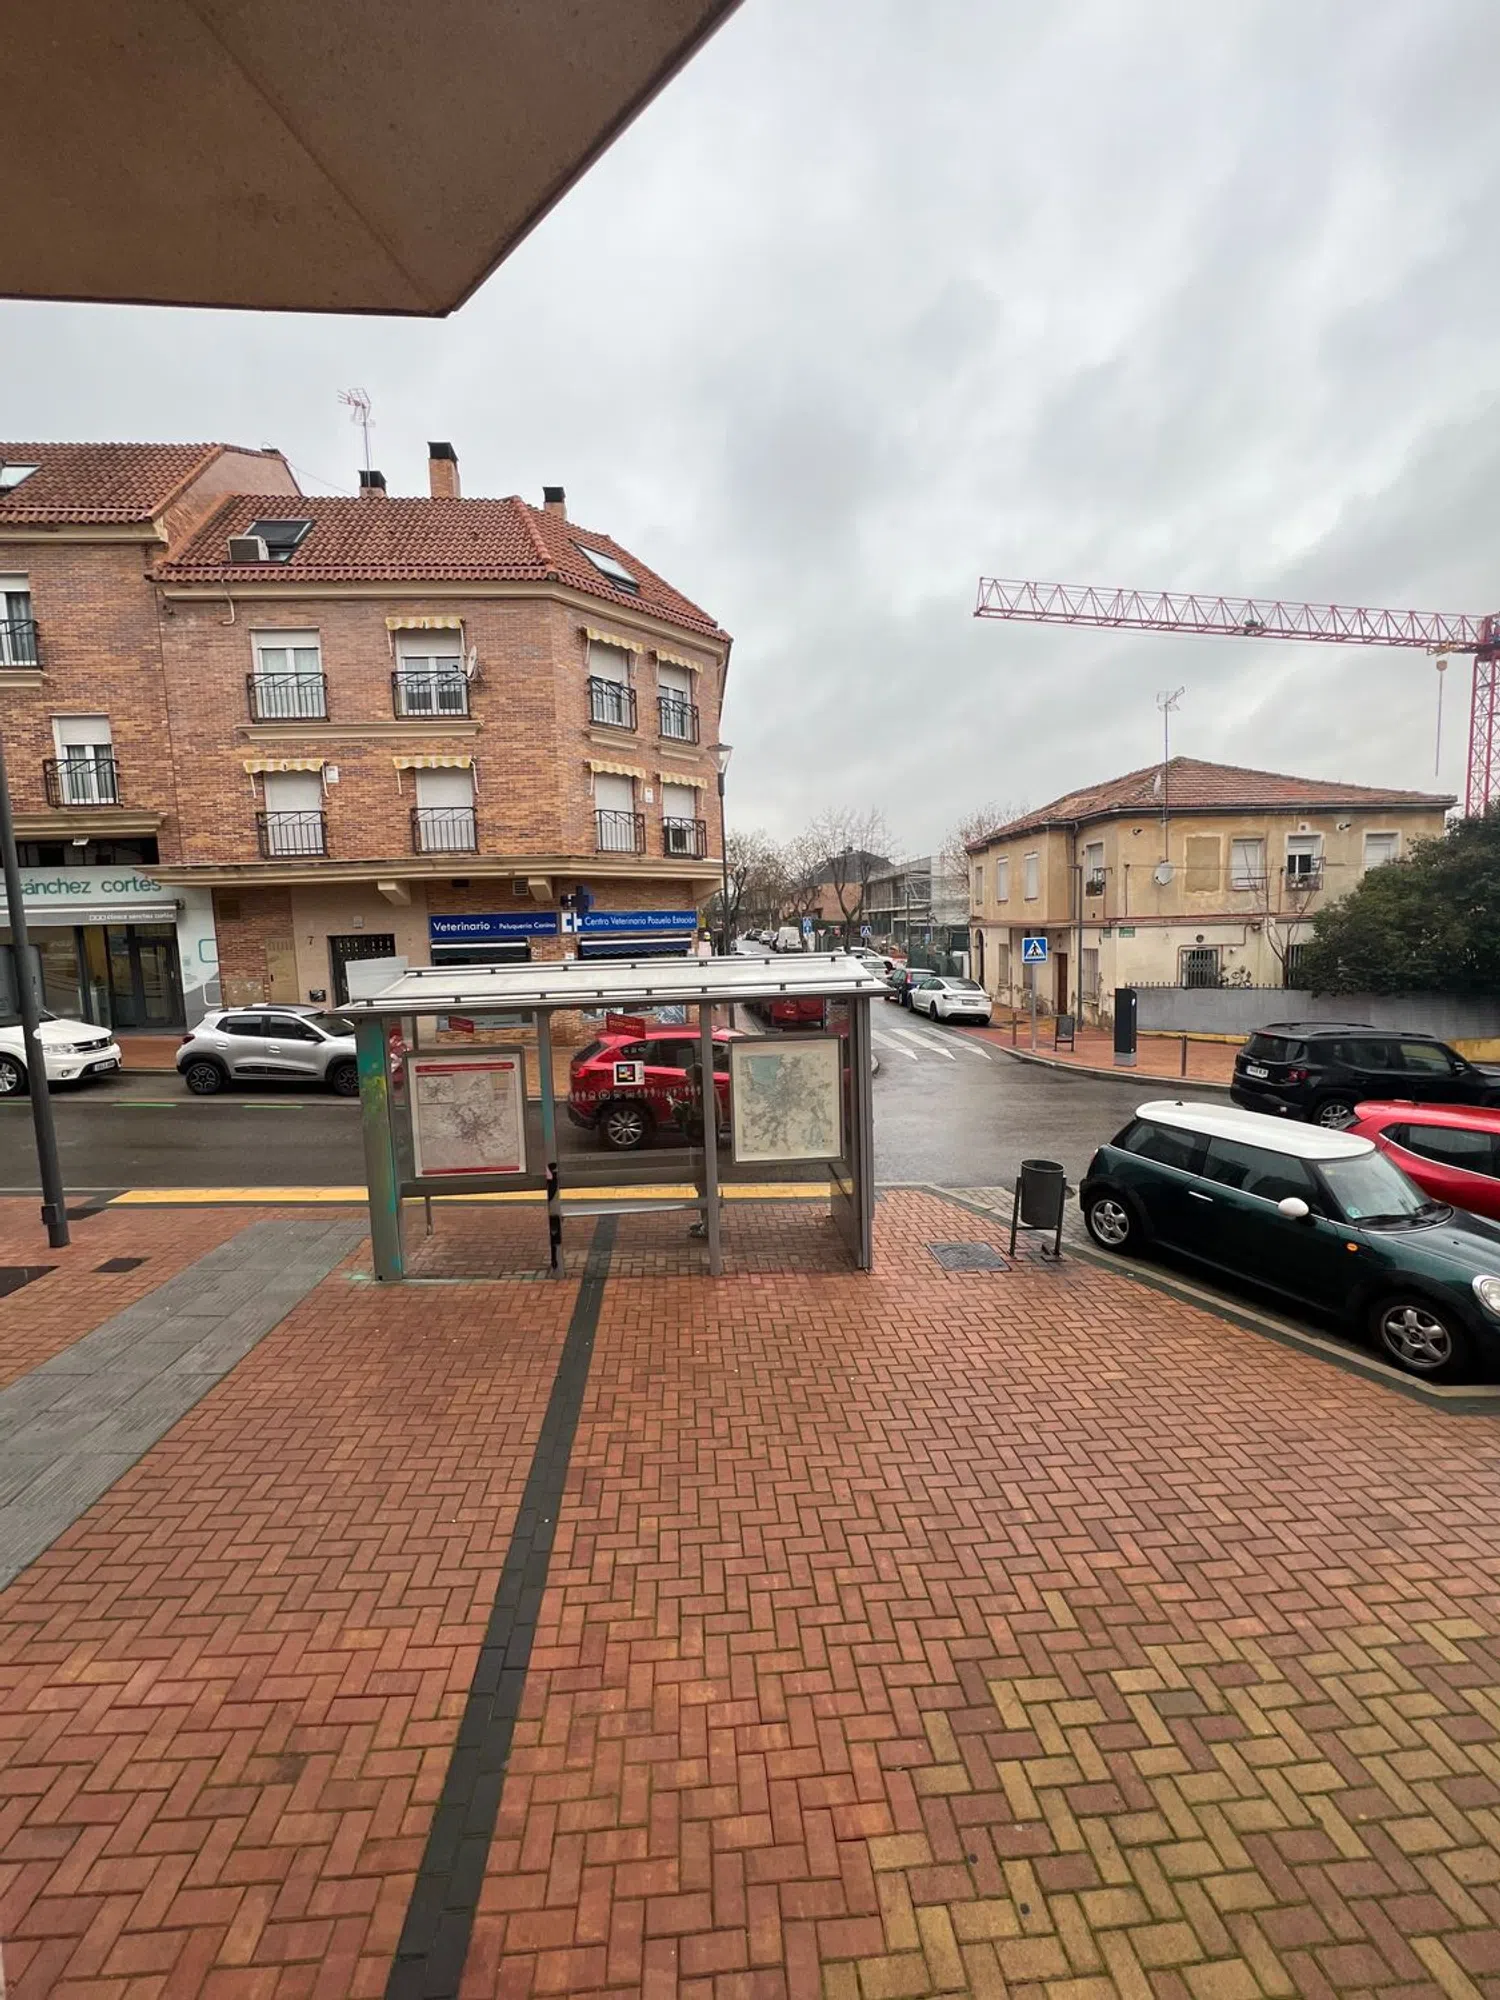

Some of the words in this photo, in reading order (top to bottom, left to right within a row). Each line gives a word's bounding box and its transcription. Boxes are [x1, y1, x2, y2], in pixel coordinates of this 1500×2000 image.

[584, 916, 609, 926] Centro
[611, 916, 646, 926] Veterinario
[647, 915, 671, 925] Pozuelo
[672, 914, 696, 924] Estación
[433, 921, 491, 932] Veterinario
[533, 921, 557, 930] Canina
[306, 935, 315, 946] 7
